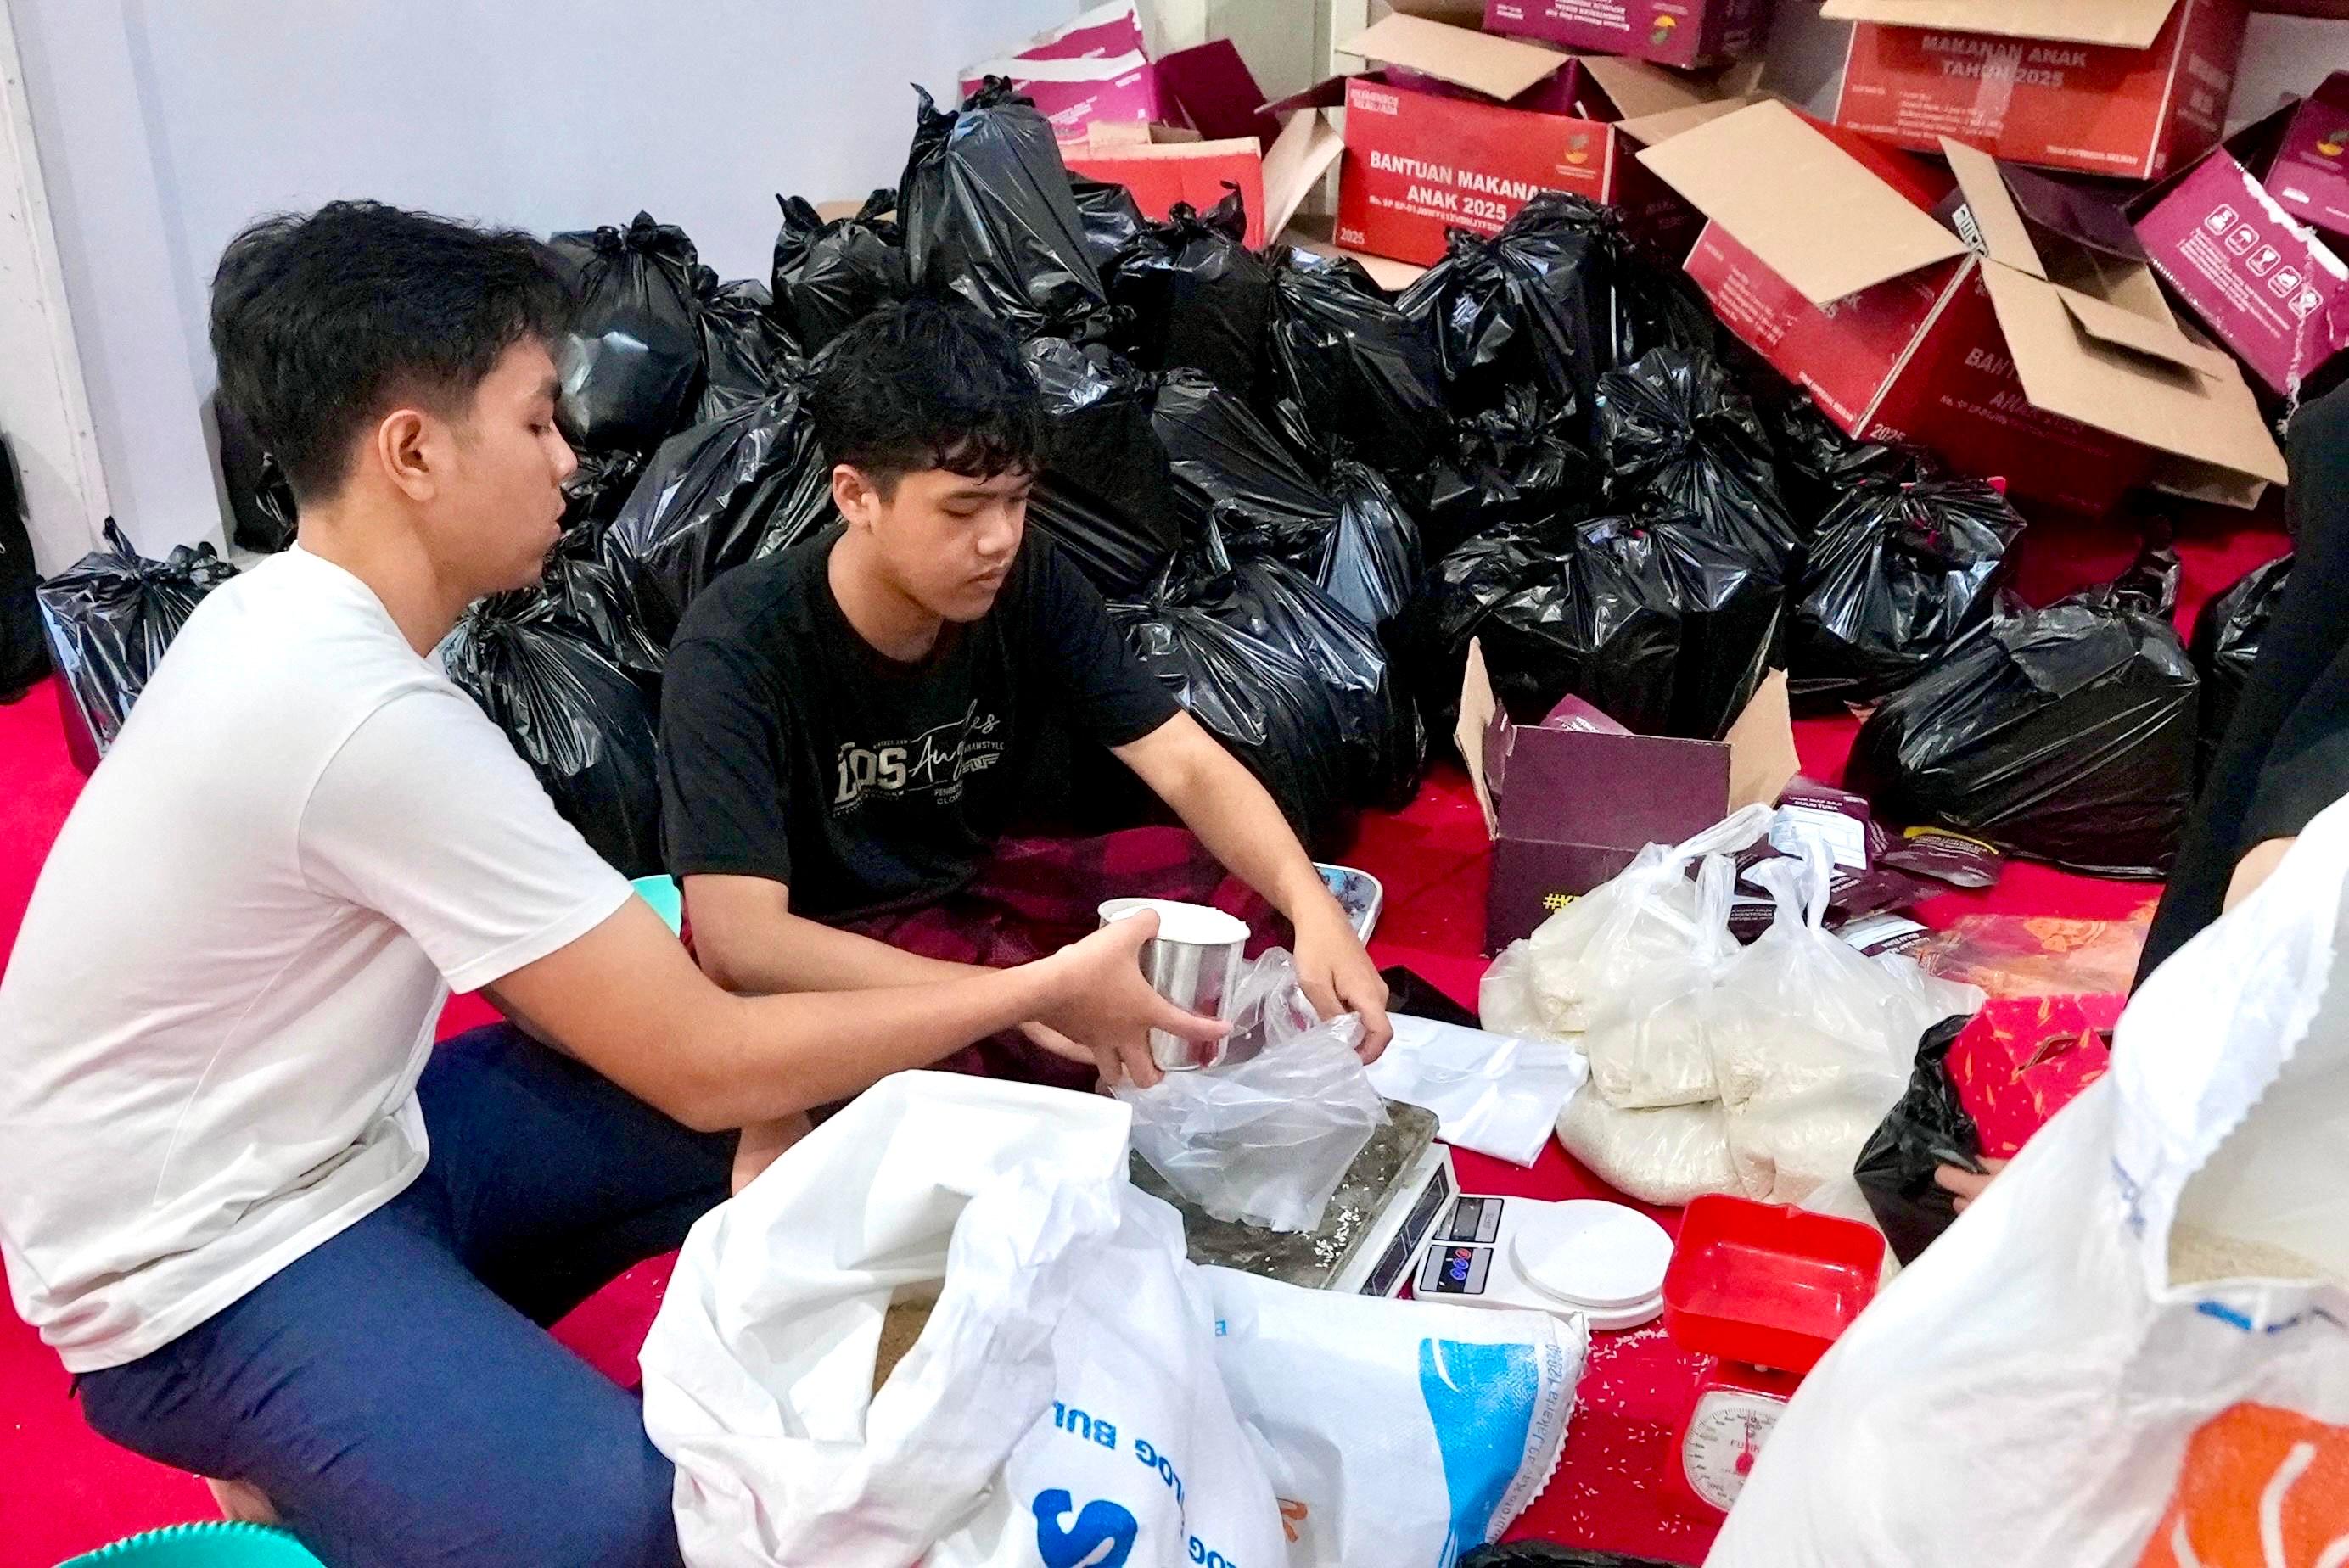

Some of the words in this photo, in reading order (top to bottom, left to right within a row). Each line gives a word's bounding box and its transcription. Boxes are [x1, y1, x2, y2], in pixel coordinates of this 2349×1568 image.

[1922, 35, 2024, 63] MAKANAN
[2027, 48, 2088, 68] ANAK
[2017, 69, 2065, 88] 2025
[1371, 149, 1453, 186] BANTUAN
[1458, 170, 1545, 202] MAKANA
[1407, 185, 1459, 211] ANAK
[1462, 197, 1507, 222] 2025
[1339, 227, 1365, 245] 2025
[1532, 1392, 1559, 1442] Jakarta
